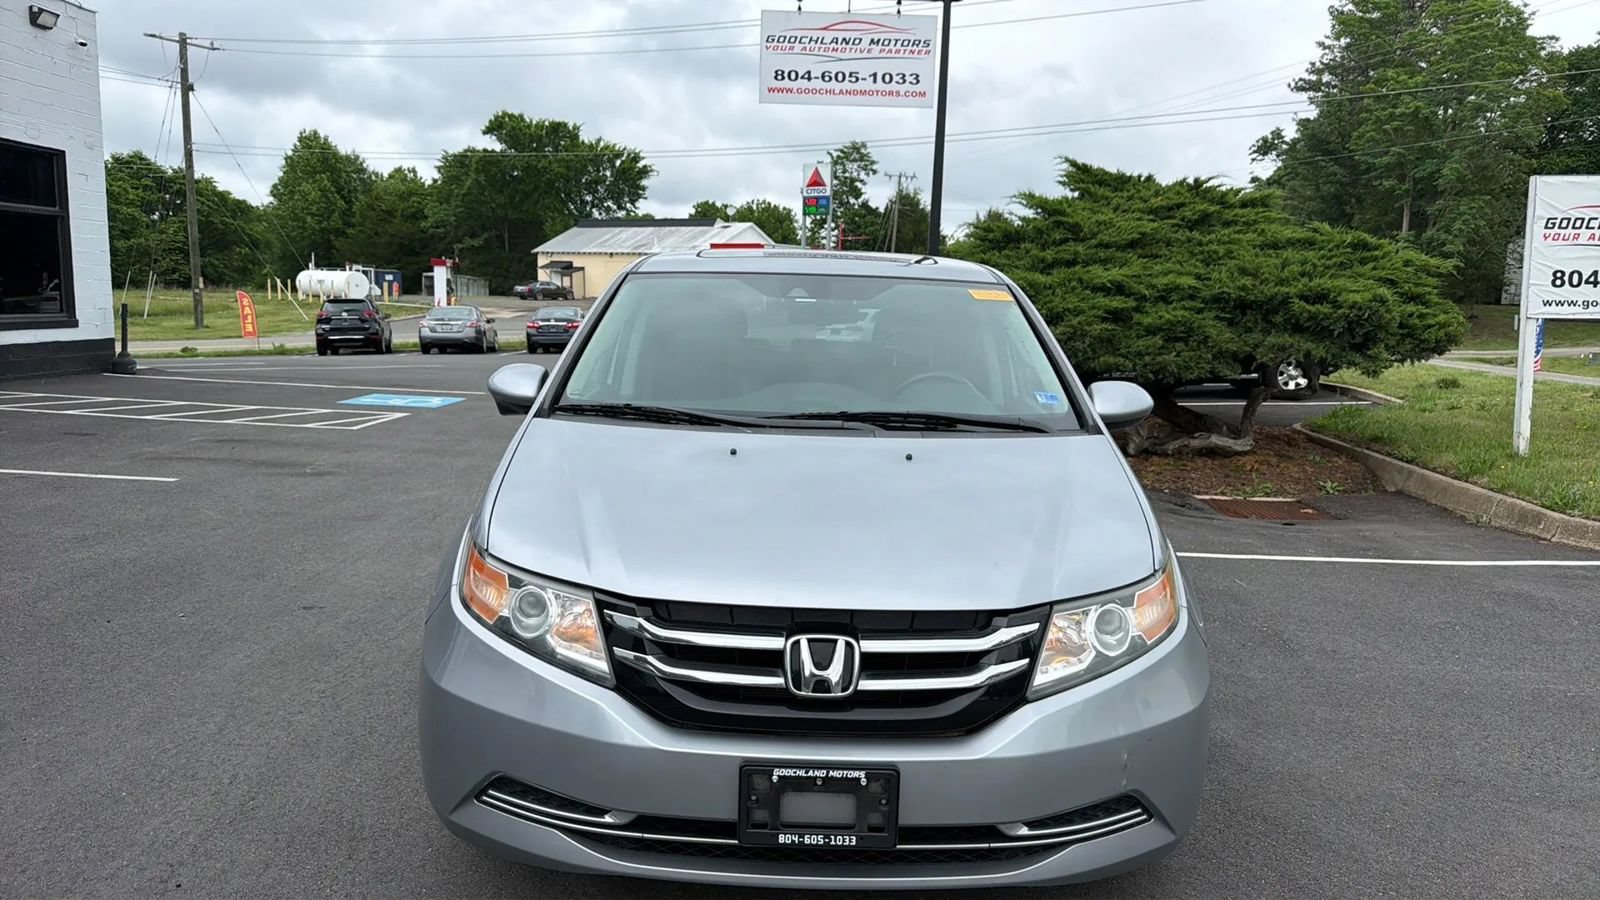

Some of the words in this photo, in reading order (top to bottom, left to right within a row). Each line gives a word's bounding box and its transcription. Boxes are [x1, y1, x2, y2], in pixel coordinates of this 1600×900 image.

[765, 34, 862, 46] GOOCHLAND
[868, 38, 931, 48] MOTORS
[800, 46, 875, 54] AUTOMOTIVE
[879, 48, 931, 56] PARTNER
[773, 69, 921, 86] 804-605-1033
[767, 86, 927, 98] WWW.GOOCHLANDMOTORS.COM
[1543, 217, 1600, 230] GOOC
[1543, 232, 1581, 241] YOUR
[773, 768, 827, 777] GOOCHLAND
[828, 770, 866, 779] MOTORS
[778, 834, 857, 845] 804-605-1033
